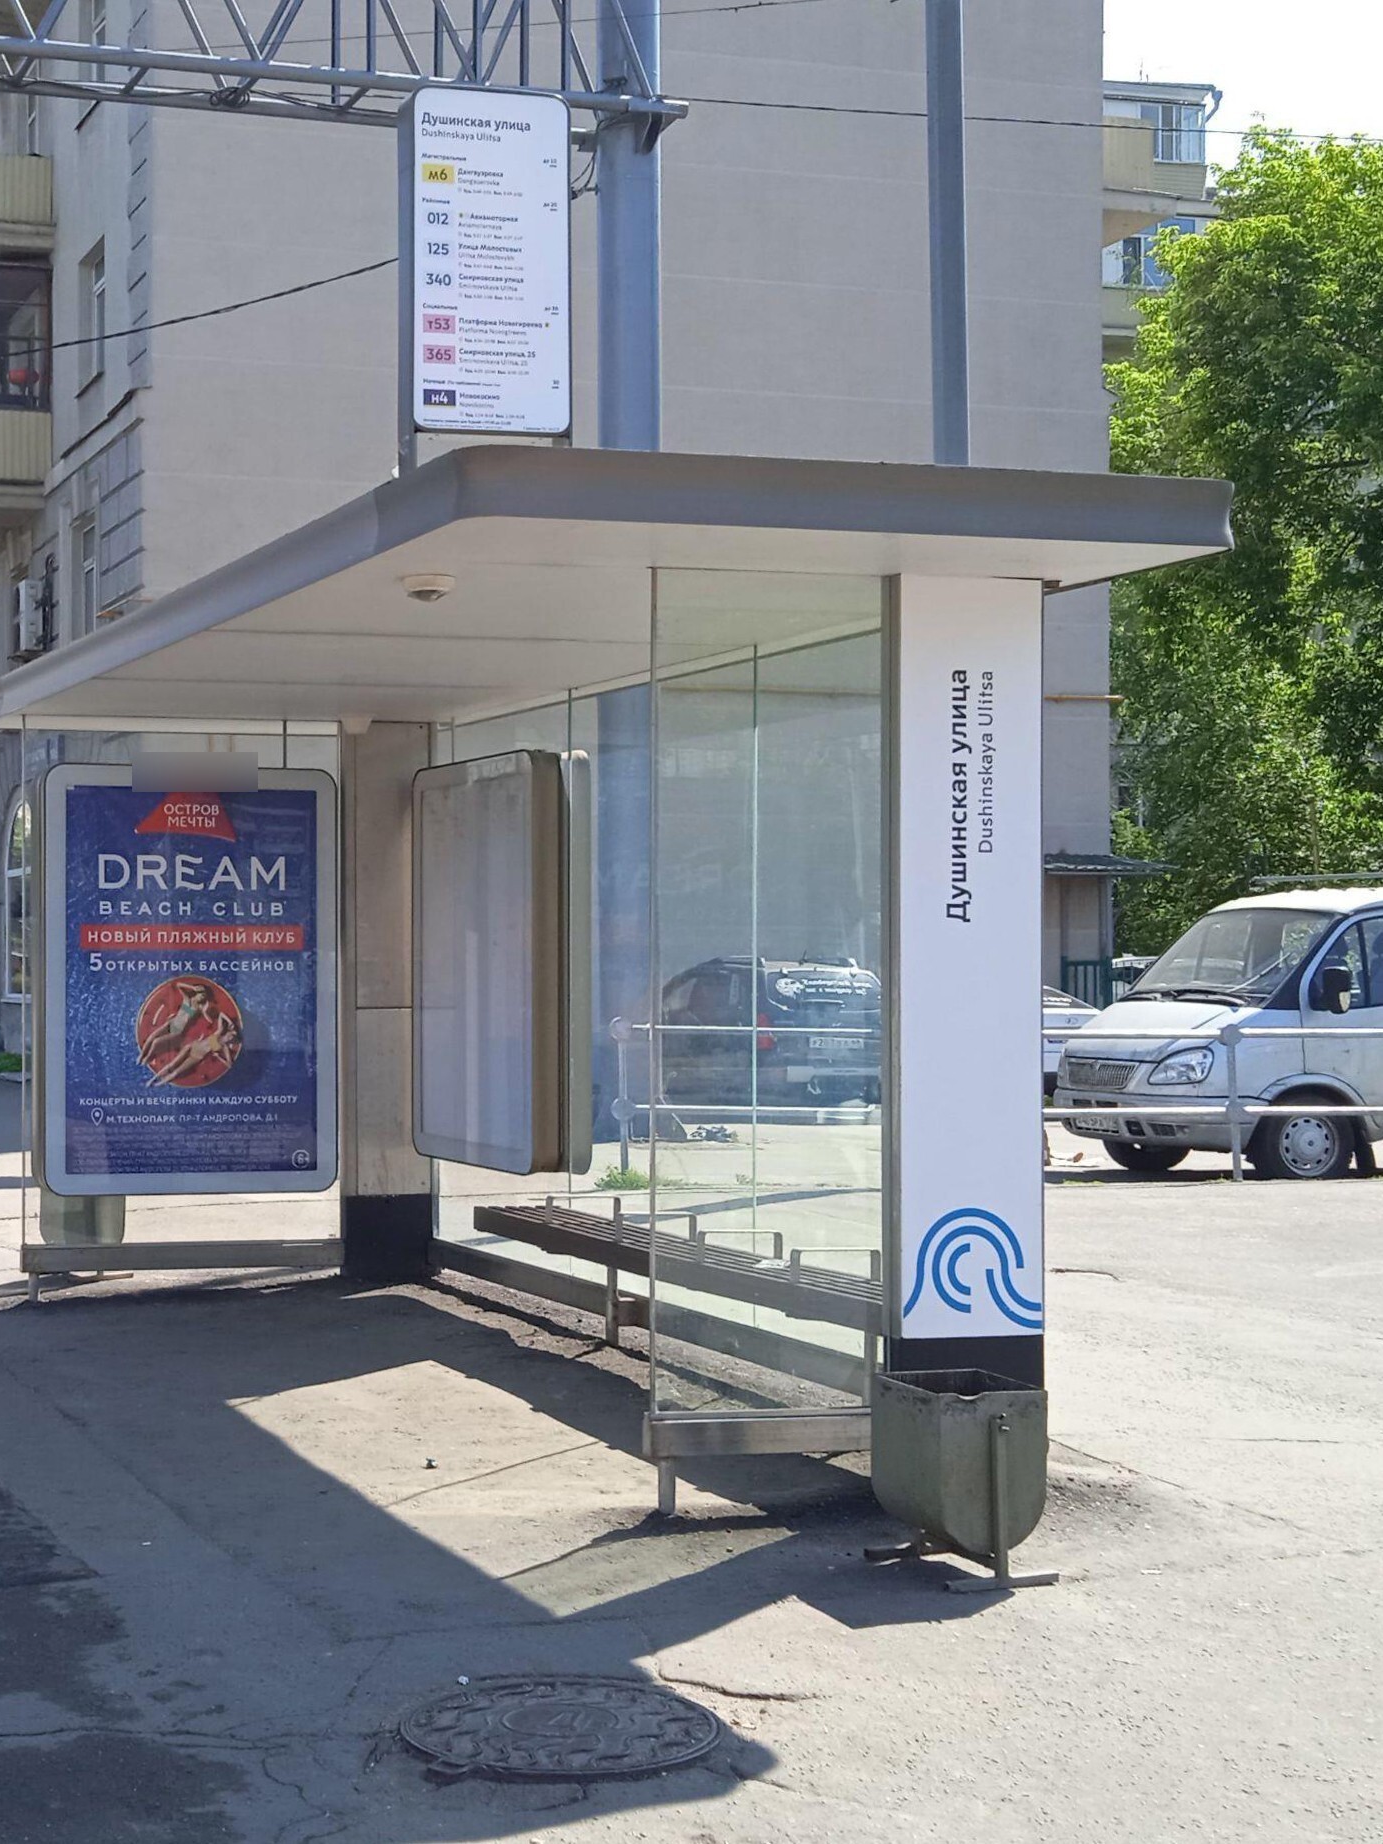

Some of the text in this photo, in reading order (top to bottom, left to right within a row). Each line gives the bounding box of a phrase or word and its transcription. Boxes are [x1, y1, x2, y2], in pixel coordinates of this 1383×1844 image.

[421, 112, 531, 133] Душинская улица
[421, 128, 501, 143] Dushinskaya Ulitsa
[427, 211, 449, 225] 012
[427, 242, 450, 256] 125
[426, 273, 452, 286] 340
[426, 348, 452, 361] 365
[977, 671, 996, 854] Dushinskaya Ulitsa
[946, 669, 972, 923] Душинская улица
[163, 804, 220, 816] ОСТРОВ
[167, 816, 217, 829] МЕЧТЫ
[97, 853, 287, 892] DREAM
[99, 900, 285, 917] BEACH CLUB
[87, 928, 295, 944] НОВЫЙ ПЛЯЖНЫЙ КЛУБ
[89, 952, 295, 972] 5 ОТКРЫТЫХ БАССЕЙНОВ
[79, 1095, 298, 1107] КОНЦЕРТЫ И ВЕЧЕРИНКИ КАЖДУЮ СУББОТУ
